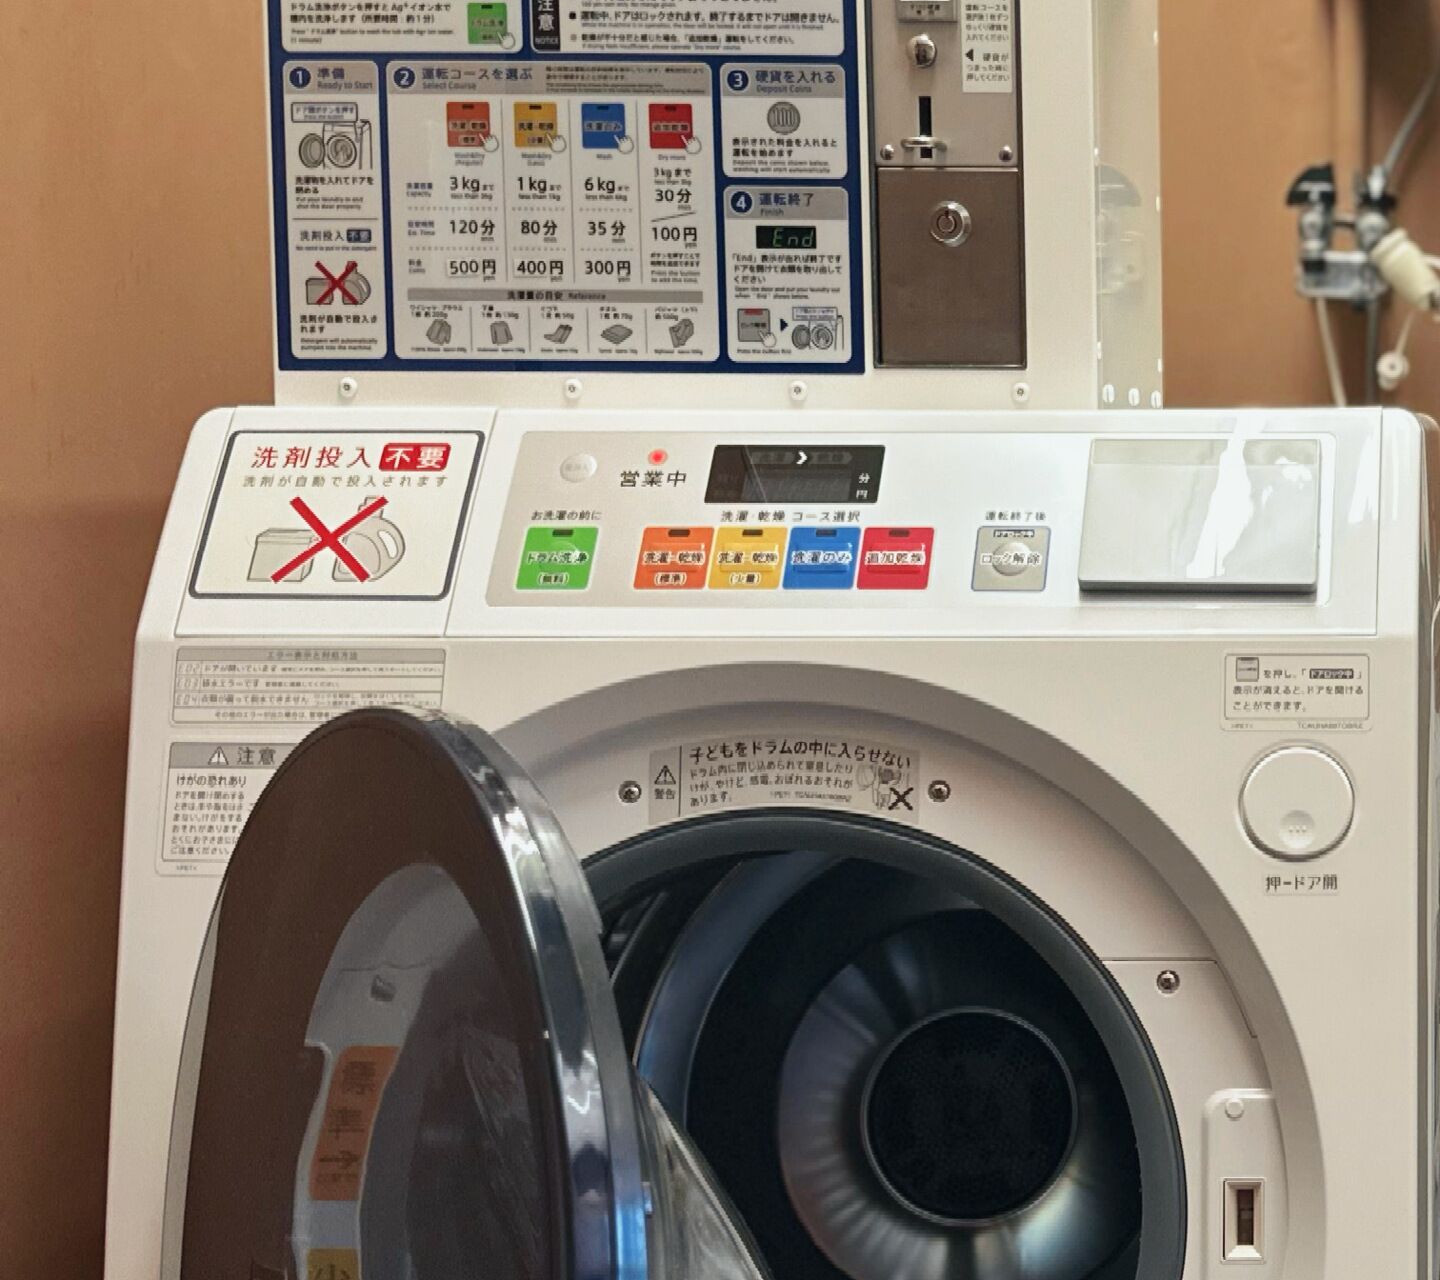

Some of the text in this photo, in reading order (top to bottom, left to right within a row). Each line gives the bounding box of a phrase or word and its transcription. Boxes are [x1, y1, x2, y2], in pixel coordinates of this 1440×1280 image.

[317, 67, 345, 80] 準備
[422, 67, 533, 82] 運転コースを選ぶ
[755, 70, 836, 84] 硬貨を入れる
[316, 79, 373, 92] Ready to Start
[449, 176, 481, 193] 3 kg
[517, 176, 547, 194] 1 kg
[584, 176, 616, 195] 6 kg
[655, 188, 693, 204] 30分
[759, 192, 814, 207] 運転終了
[449, 219, 496, 236] 120分
[520, 219, 558, 236] 80分
[587, 221, 626, 237] 35分
[651, 226, 698, 242] 100円
[771, 227, 815, 249] End
[449, 259, 497, 276] 500円
[516, 259, 565, 276] 400円
[585, 260, 631, 277] 300円
[249, 445, 448, 470] 洗剤投入 不要
[242, 474, 448, 488] 洗剤が自動で投入されます
[620, 469, 687, 488] 営業中
[531, 509, 600, 521] お洗濯の前に
[719, 509, 863, 524] 洗濯・乾燥 コース選択
[985, 511, 1046, 521] 運転終了後
[522, 550, 591, 566] ドラム洗浄
[790, 550, 854, 566] 洗濯のみ
[864, 550, 927, 566] 追加乾燥
[979, 551, 1044, 567] ロック解除
[1232, 685, 1364, 695] 表示が消えると、ドアを開ける
[1232, 700, 1306, 713] ことができます。
[237, 746, 276, 766] 注意
[688, 740, 912, 770] 子どもをドラムの中に入らせない
